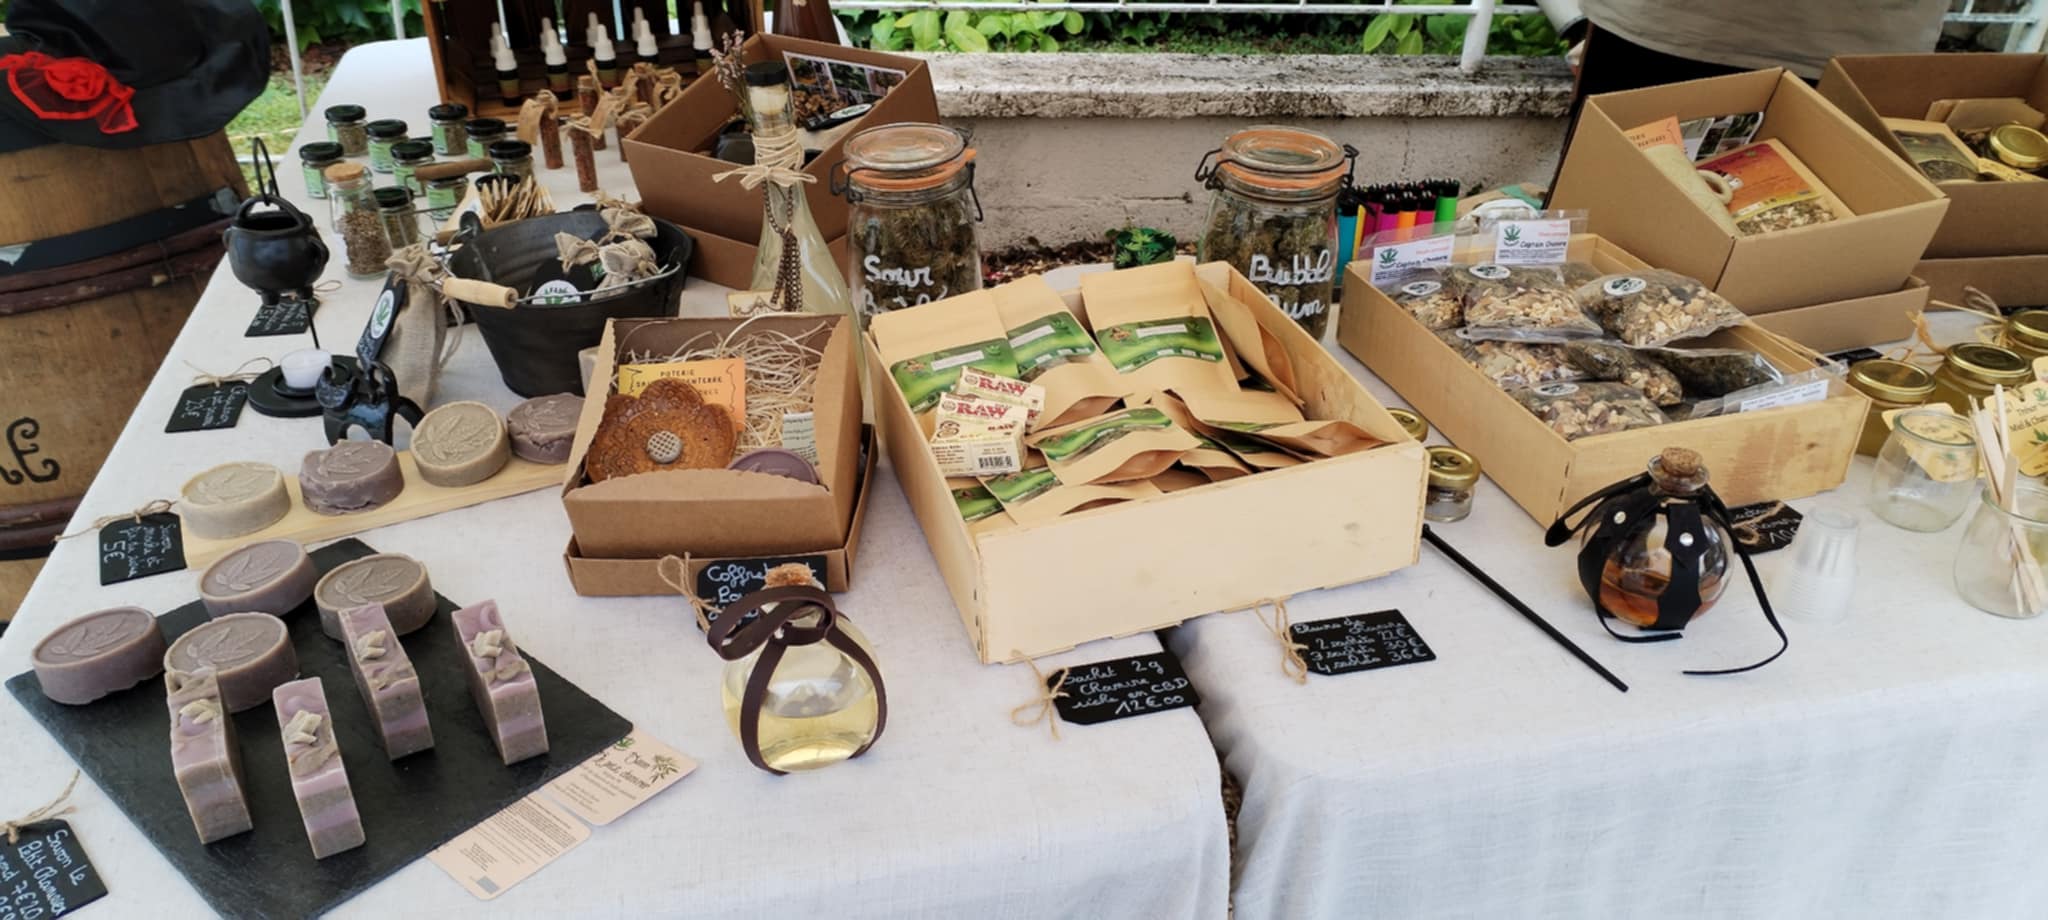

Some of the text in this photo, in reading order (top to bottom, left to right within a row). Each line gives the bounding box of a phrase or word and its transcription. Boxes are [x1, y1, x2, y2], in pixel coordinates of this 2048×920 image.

[978, 376, 1029, 398] RAW
[956, 402, 1012, 419] RAW
[103, 540, 126, 564] 5€
[1315, 638, 1329, 650] 2
[1310, 651, 1323, 661] 3
[1316, 662, 1332, 673] 4
[1151, 677, 1188, 693] CBD
[18, 840, 47, 870] Petit
[46, 829, 73, 868] Savon
